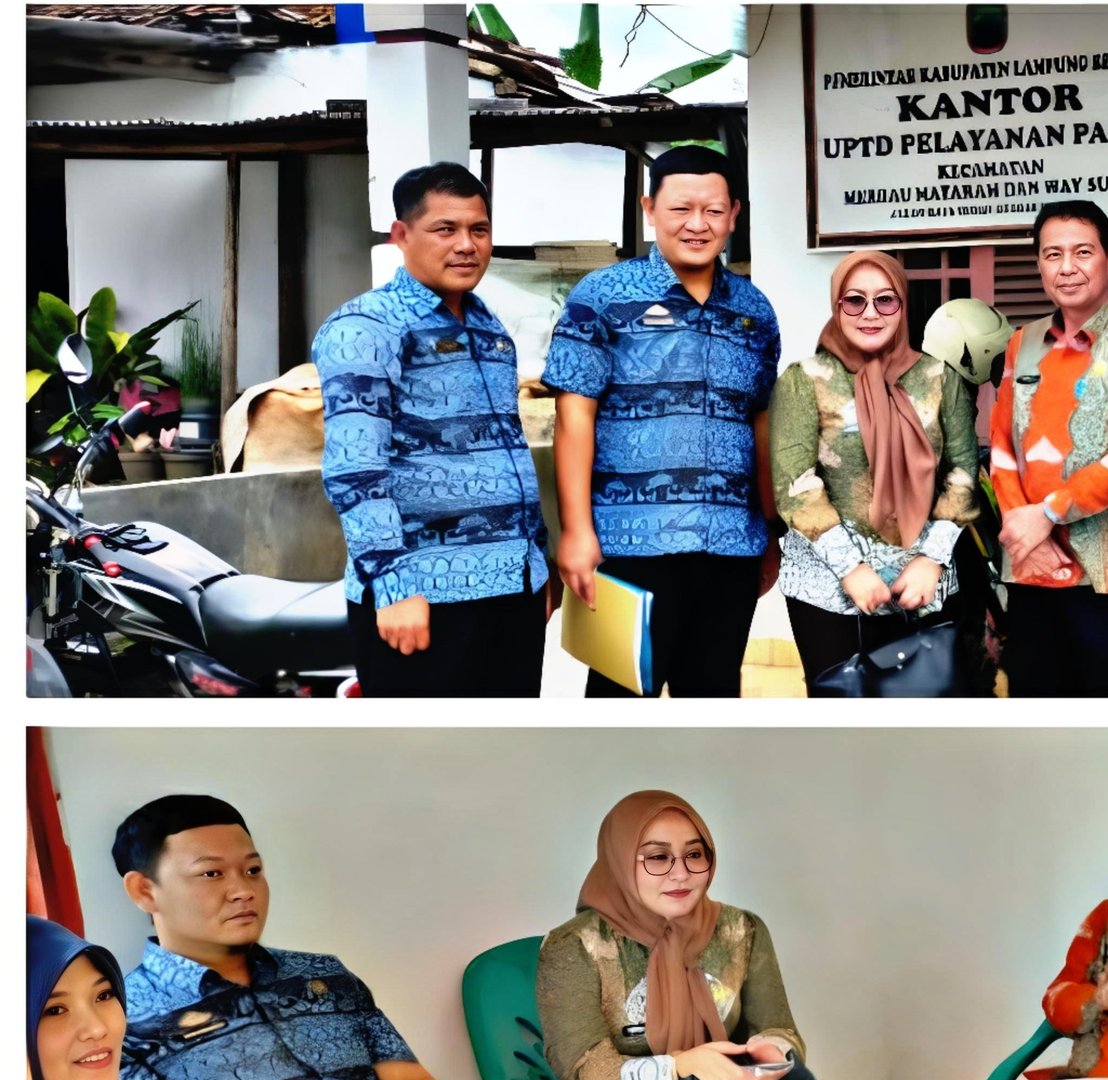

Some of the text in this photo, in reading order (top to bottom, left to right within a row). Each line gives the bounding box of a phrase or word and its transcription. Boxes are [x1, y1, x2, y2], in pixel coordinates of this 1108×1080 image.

[896, 83, 1084, 123] KANTOR
[823, 135, 894, 159] UPTD
[900, 123, 1066, 156] PELAYANAN
